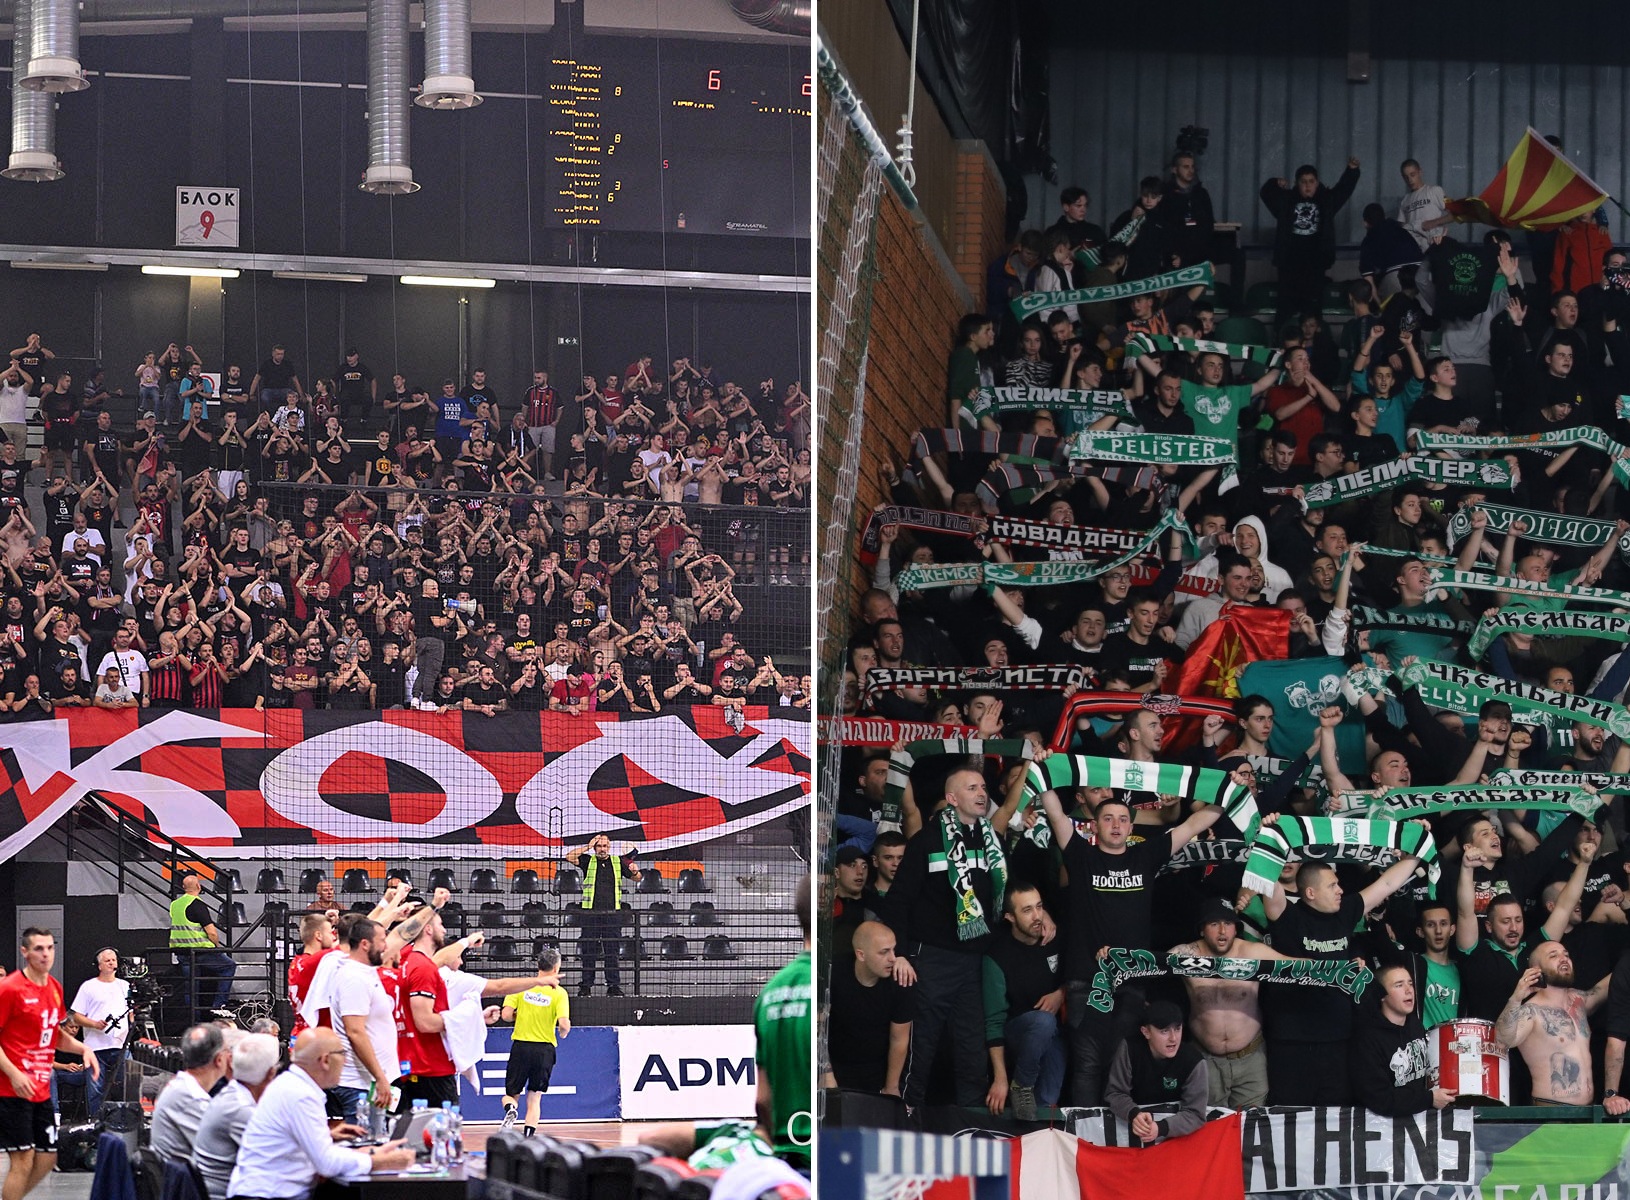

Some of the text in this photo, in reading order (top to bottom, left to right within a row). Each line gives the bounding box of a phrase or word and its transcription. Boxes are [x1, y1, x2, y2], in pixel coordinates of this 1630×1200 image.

[708, 70, 721, 90] 6
[614, 86, 622, 96] 8
[614, 134, 622, 143] 8
[608, 145, 615, 155] 2
[614, 180, 621, 190] 3
[181, 192, 235, 206] БЛОК
[607, 192, 614, 202] 6
[200, 210, 215, 239] 9
[994, 387, 1123, 405] ПЕЛИСТЕР
[1336, 456, 1476, 493] ПЕЛИСТЕР
[1041, 563, 1094, 576] БИТО
[1485, 611, 1630, 635] ЧКЕМБАР
[1428, 663, 1613, 721] ЧКЕМБАРИ
[1557, 729, 1574, 747] 11
[1520, 771, 1582, 786] Green
[1385, 788, 1572, 810] ЧКЕМБАРИ
[1092, 874, 1144, 889] HOOLIGAN
[39, 1009, 59, 1029] 14
[634, 1054, 756, 1092] ADM
[1244, 1106, 1473, 1188] ATHENS
